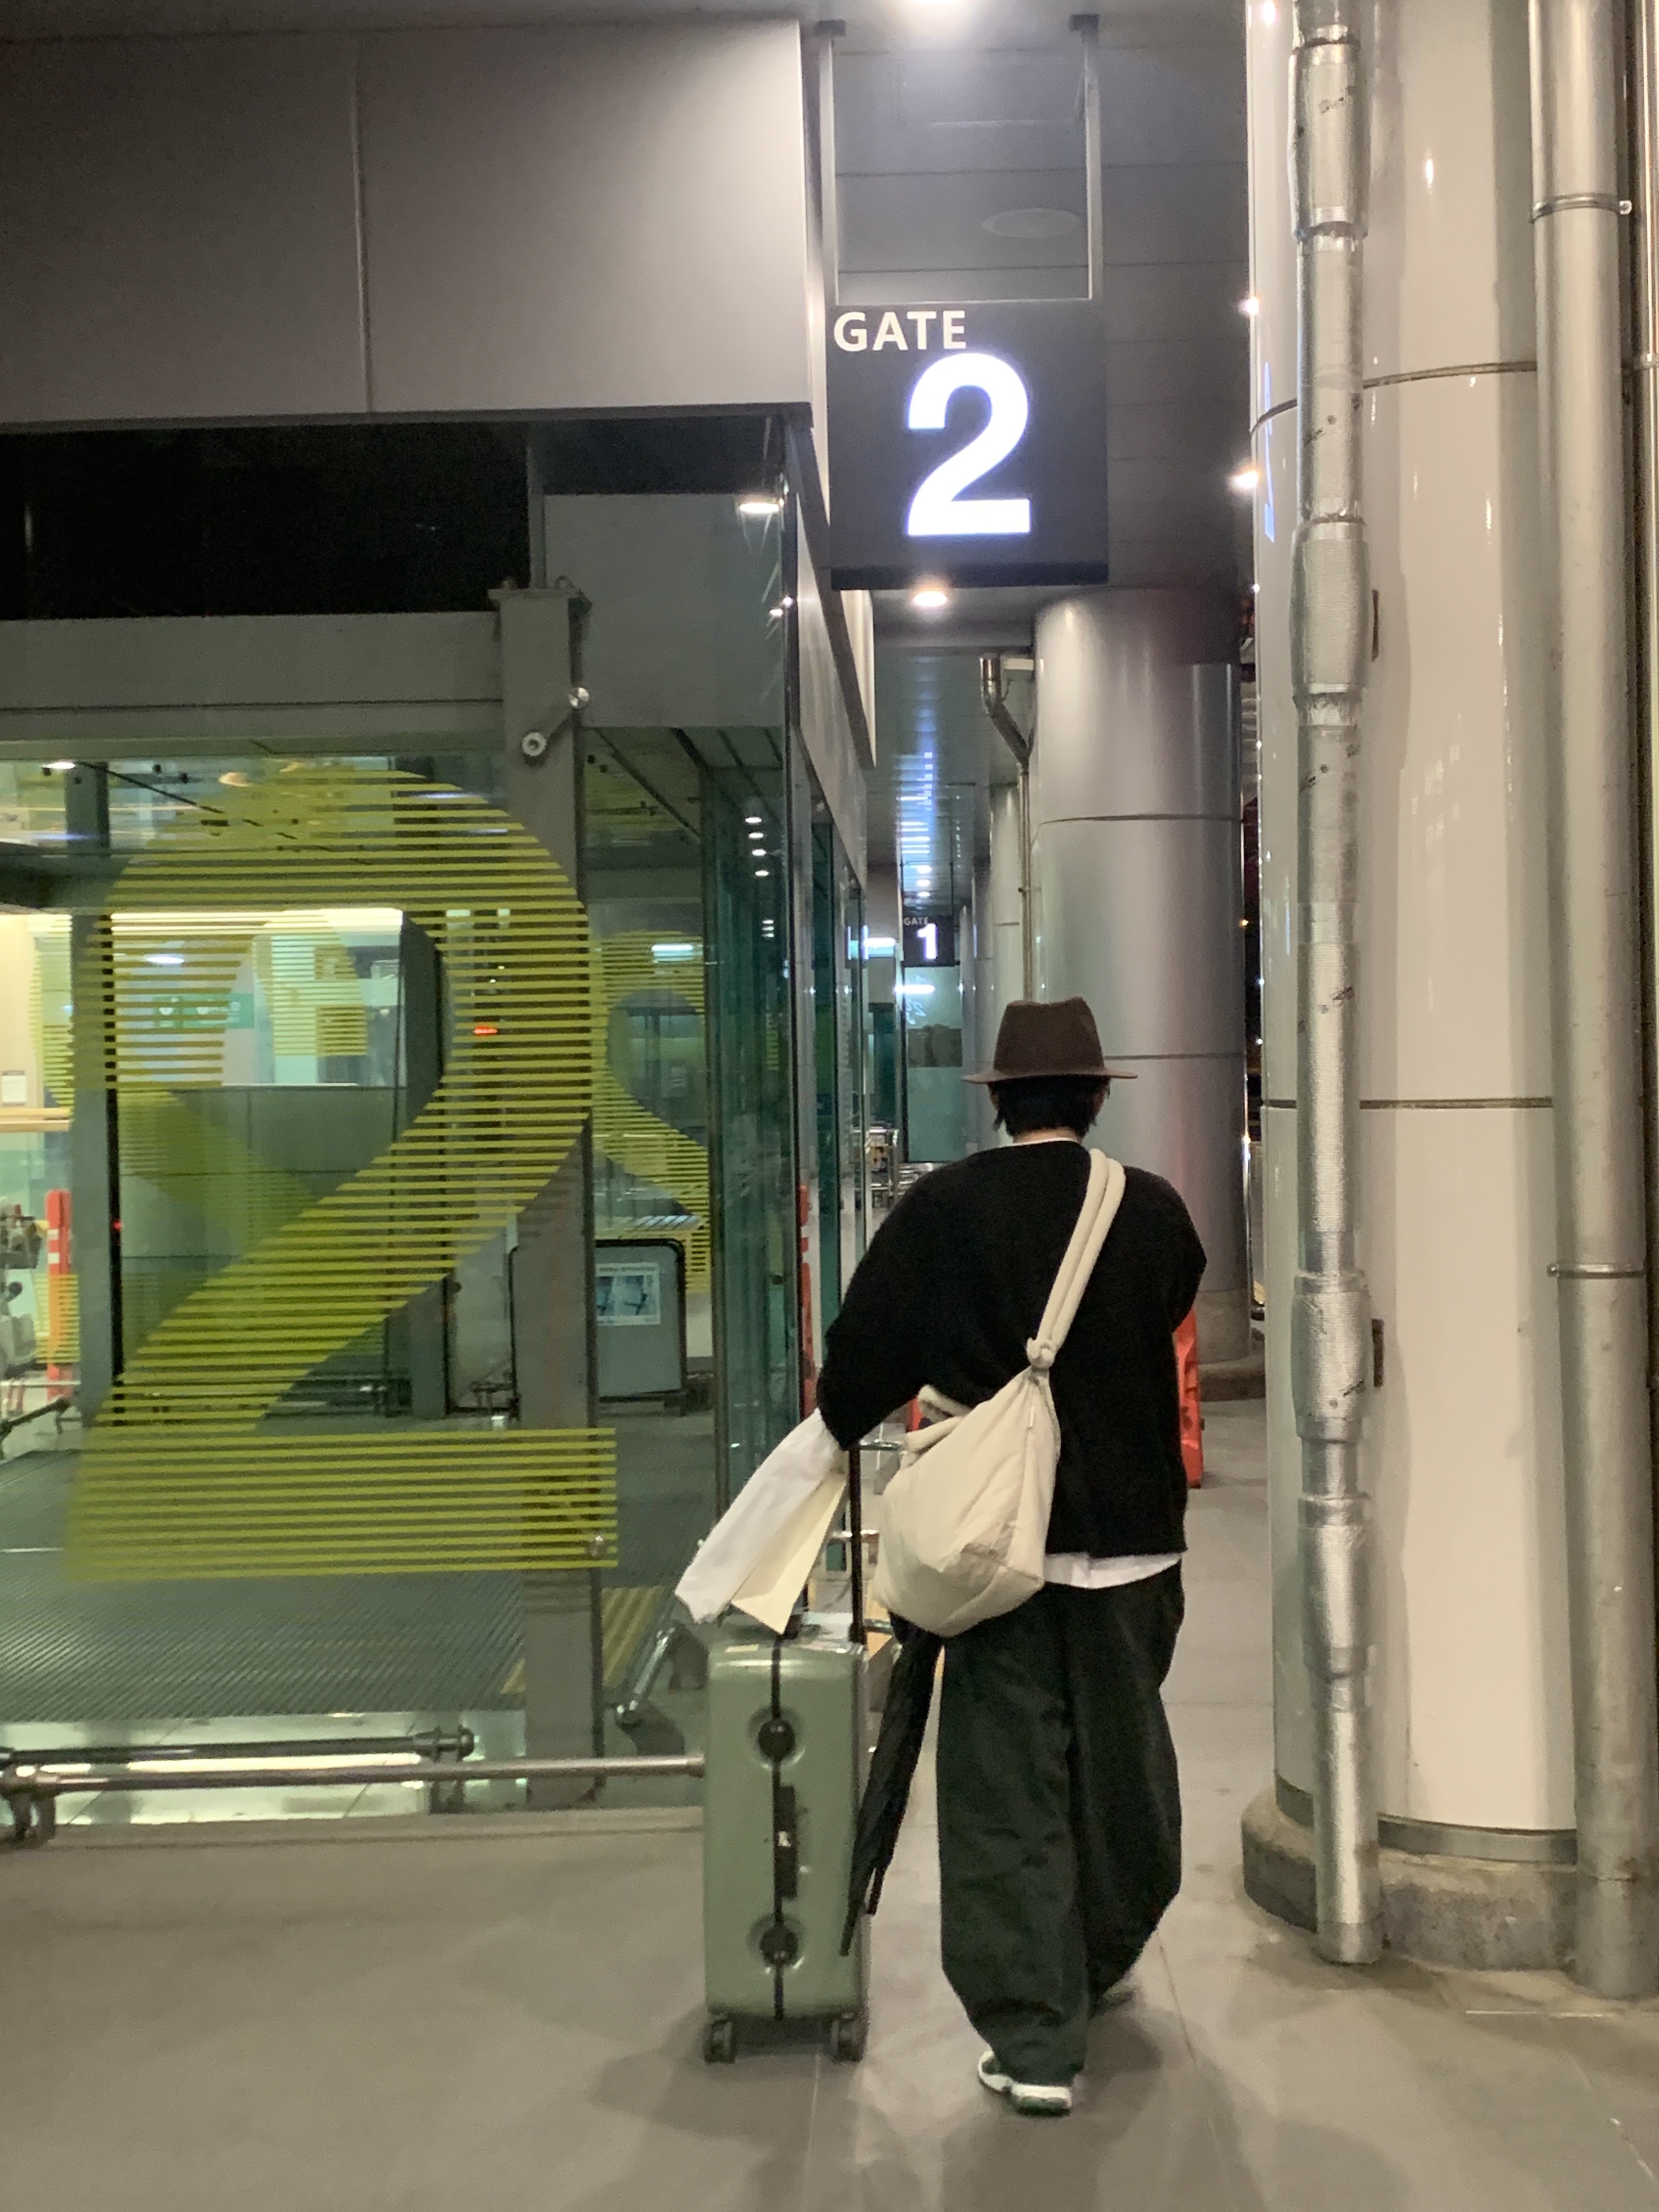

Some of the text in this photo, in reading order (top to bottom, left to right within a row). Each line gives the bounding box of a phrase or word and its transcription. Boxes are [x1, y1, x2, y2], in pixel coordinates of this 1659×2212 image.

[834, 310, 966, 351] GATE
[908, 353, 1030, 536] 2
[904, 917, 928, 925] GATE
[917, 923, 937, 959] 1
[63, 766, 618, 1574] 2
